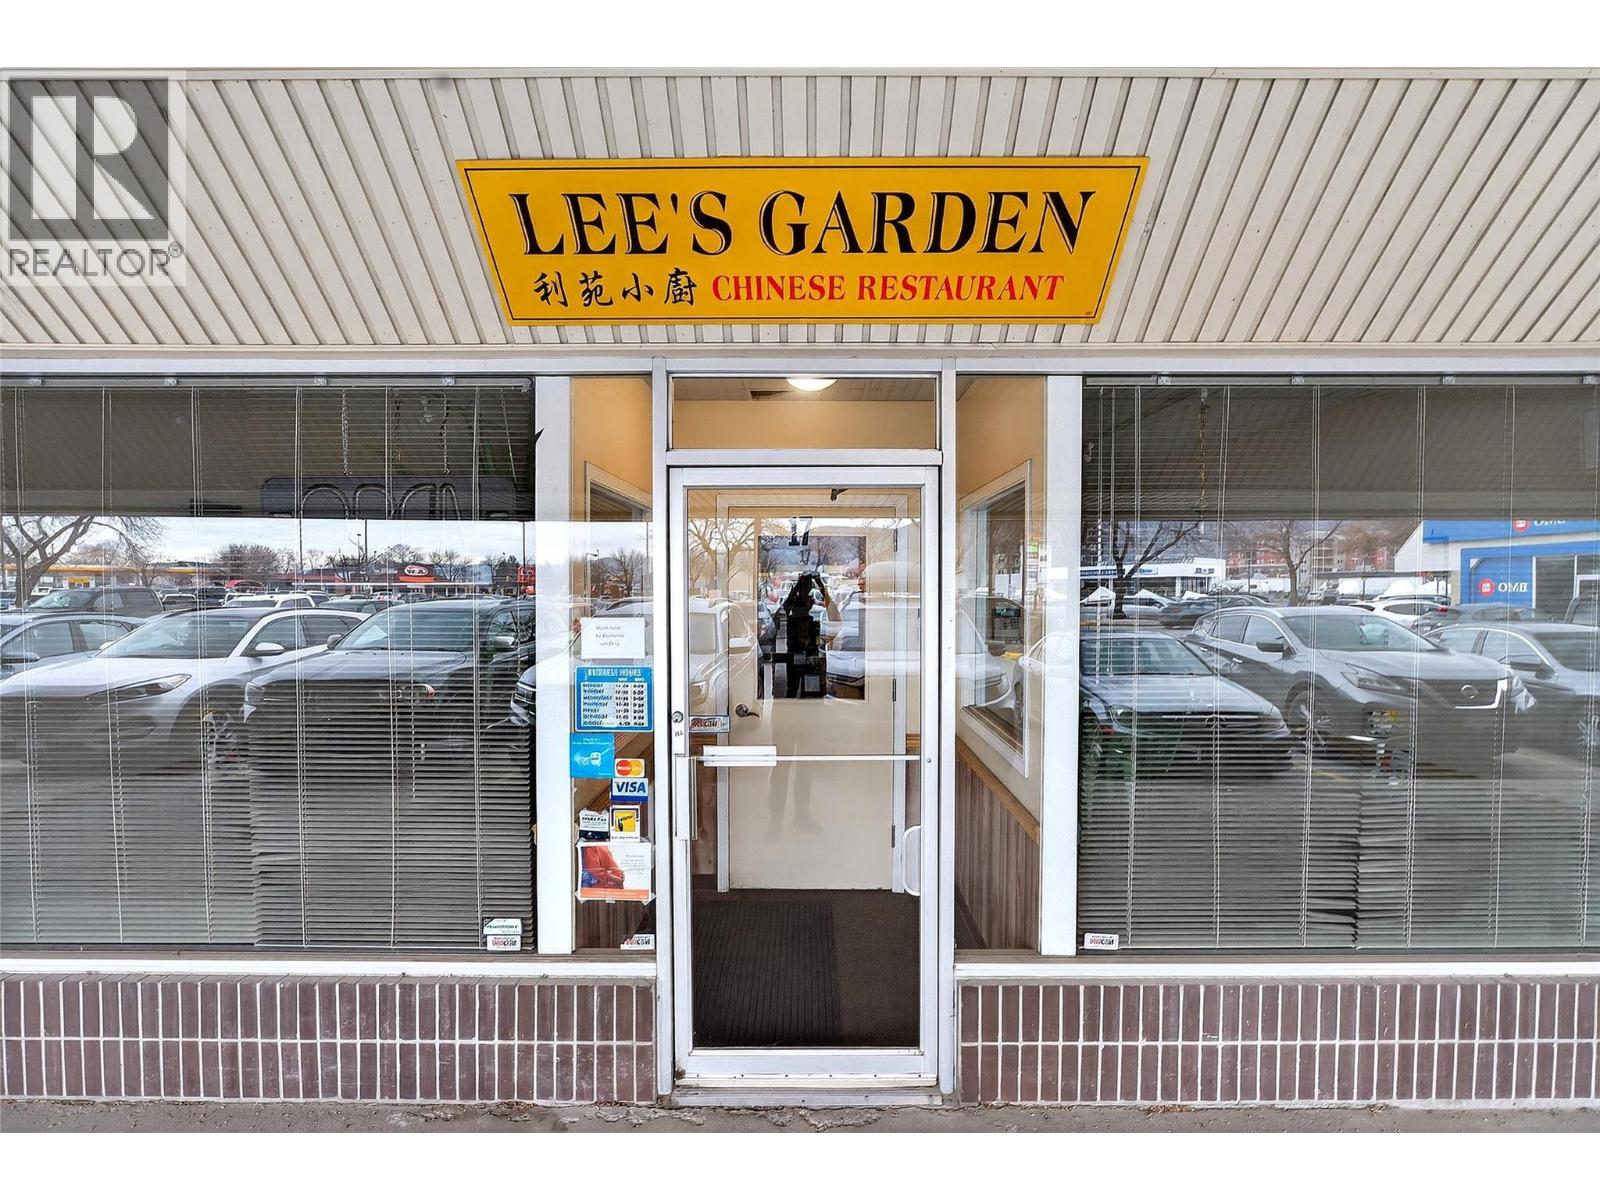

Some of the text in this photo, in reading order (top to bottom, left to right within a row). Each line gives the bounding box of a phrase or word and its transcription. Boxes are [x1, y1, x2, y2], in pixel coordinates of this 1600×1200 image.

[508, 190, 1096, 256] LEE'S GARDEN
[533, 267, 697, 308] 利苑小廚
[712, 274, 1064, 301] CHINESE RESTAURANT
[788, 516, 813, 546] 17
[614, 781, 646, 793] VISA
